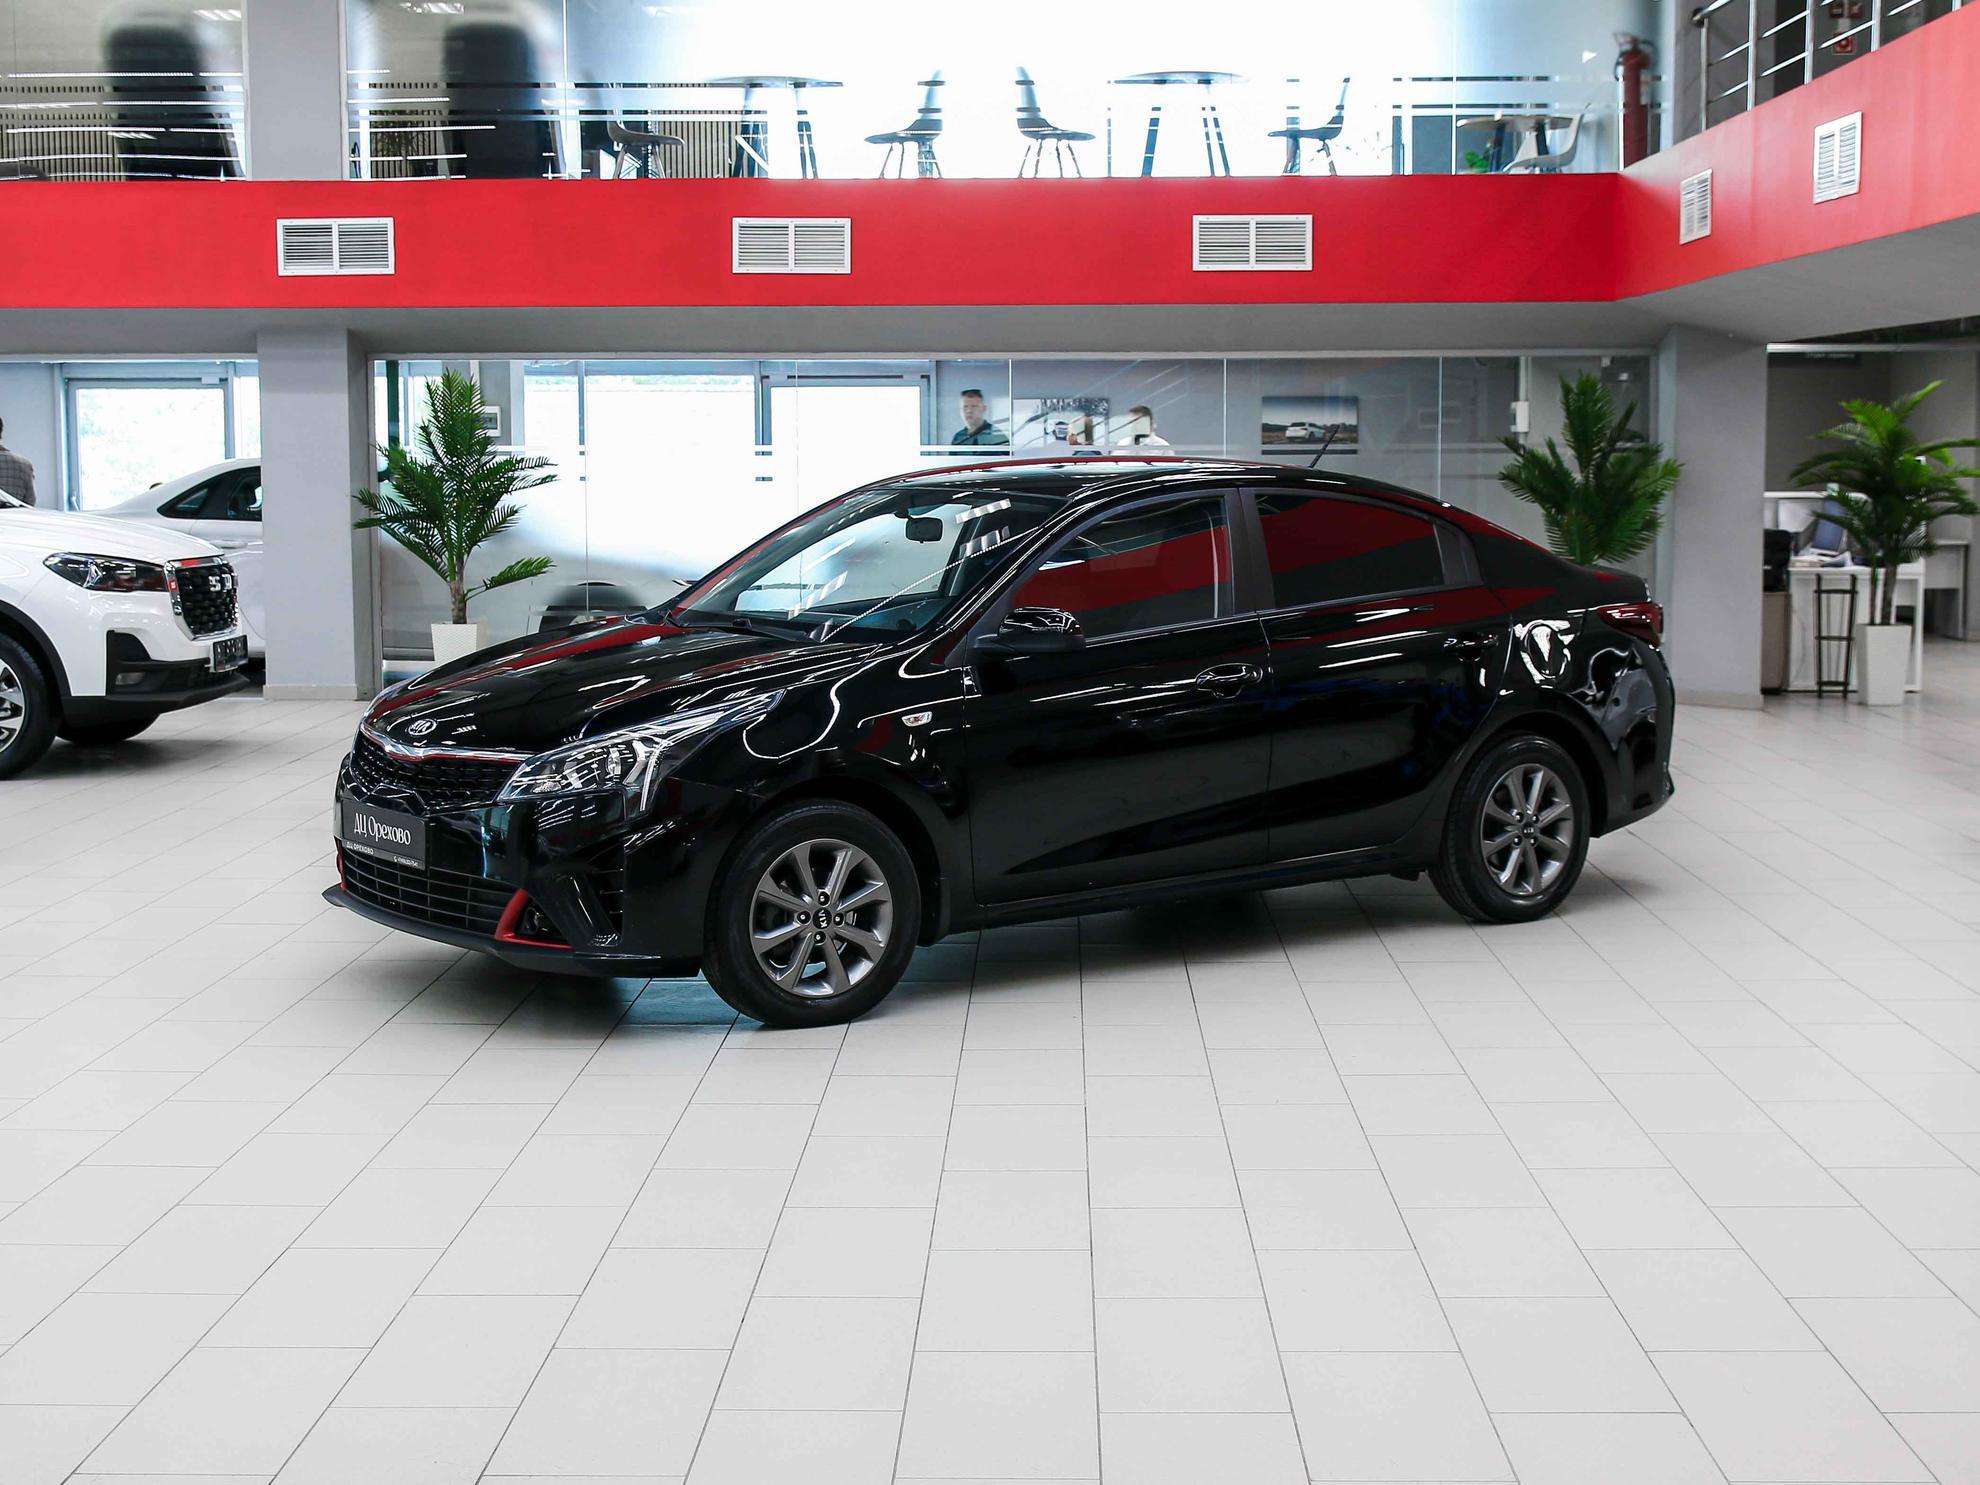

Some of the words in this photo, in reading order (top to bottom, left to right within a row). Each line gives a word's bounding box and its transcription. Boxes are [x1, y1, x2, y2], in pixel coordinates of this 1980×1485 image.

[410, 719, 432, 734] KIA
[353, 812, 367, 837] ДЦ
[368, 815, 411, 845] Орехово
[818, 910, 828, 928] KIA
